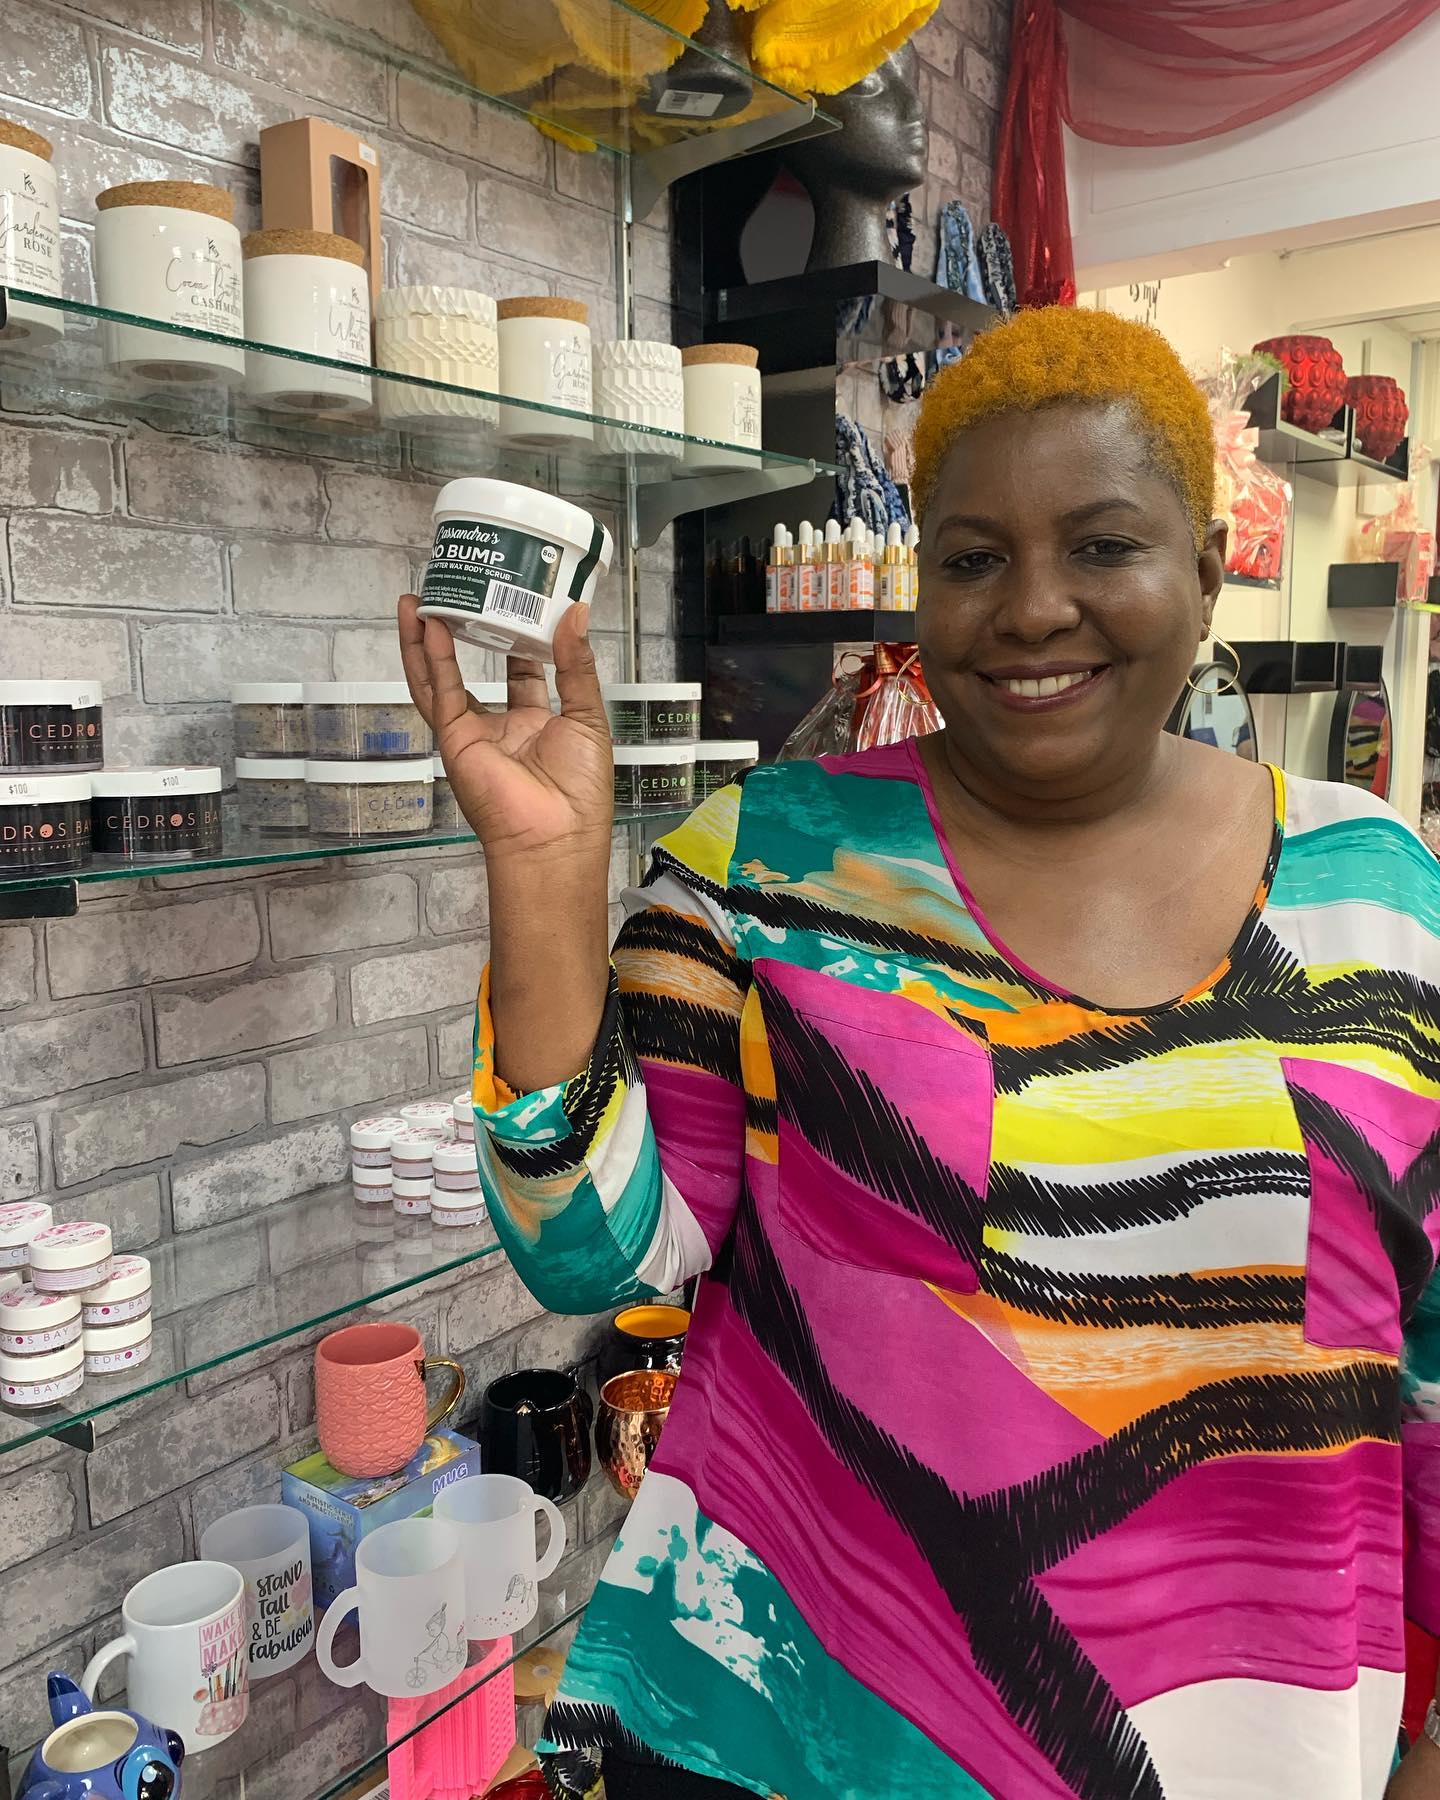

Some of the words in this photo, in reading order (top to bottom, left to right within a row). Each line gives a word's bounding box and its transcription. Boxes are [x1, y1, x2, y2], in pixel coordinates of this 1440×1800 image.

[24, 237, 52, 258] ROSE
[1143, 284, 1158, 320] my
[436, 526, 500, 545] Cassandra's
[446, 544, 505, 566] BUMP
[434, 562, 449, 570] AFTER
[449, 563, 463, 571] WAX
[464, 564, 484, 574] BODY
[484, 568, 513, 582] SCRUB)
[8, 783, 28, 796] $100
[162, 776, 180, 787] $100
[106, 812, 196, 829] CEDROS
[43, 1327, 70, 1342] BAY
[34, 1382, 60, 1396] BAY
[432, 1462, 468, 1494] MUG
[202, 1614, 236, 1642] WAKE
[252, 1622, 262, 1641] &
[266, 1616, 282, 1638] BE
